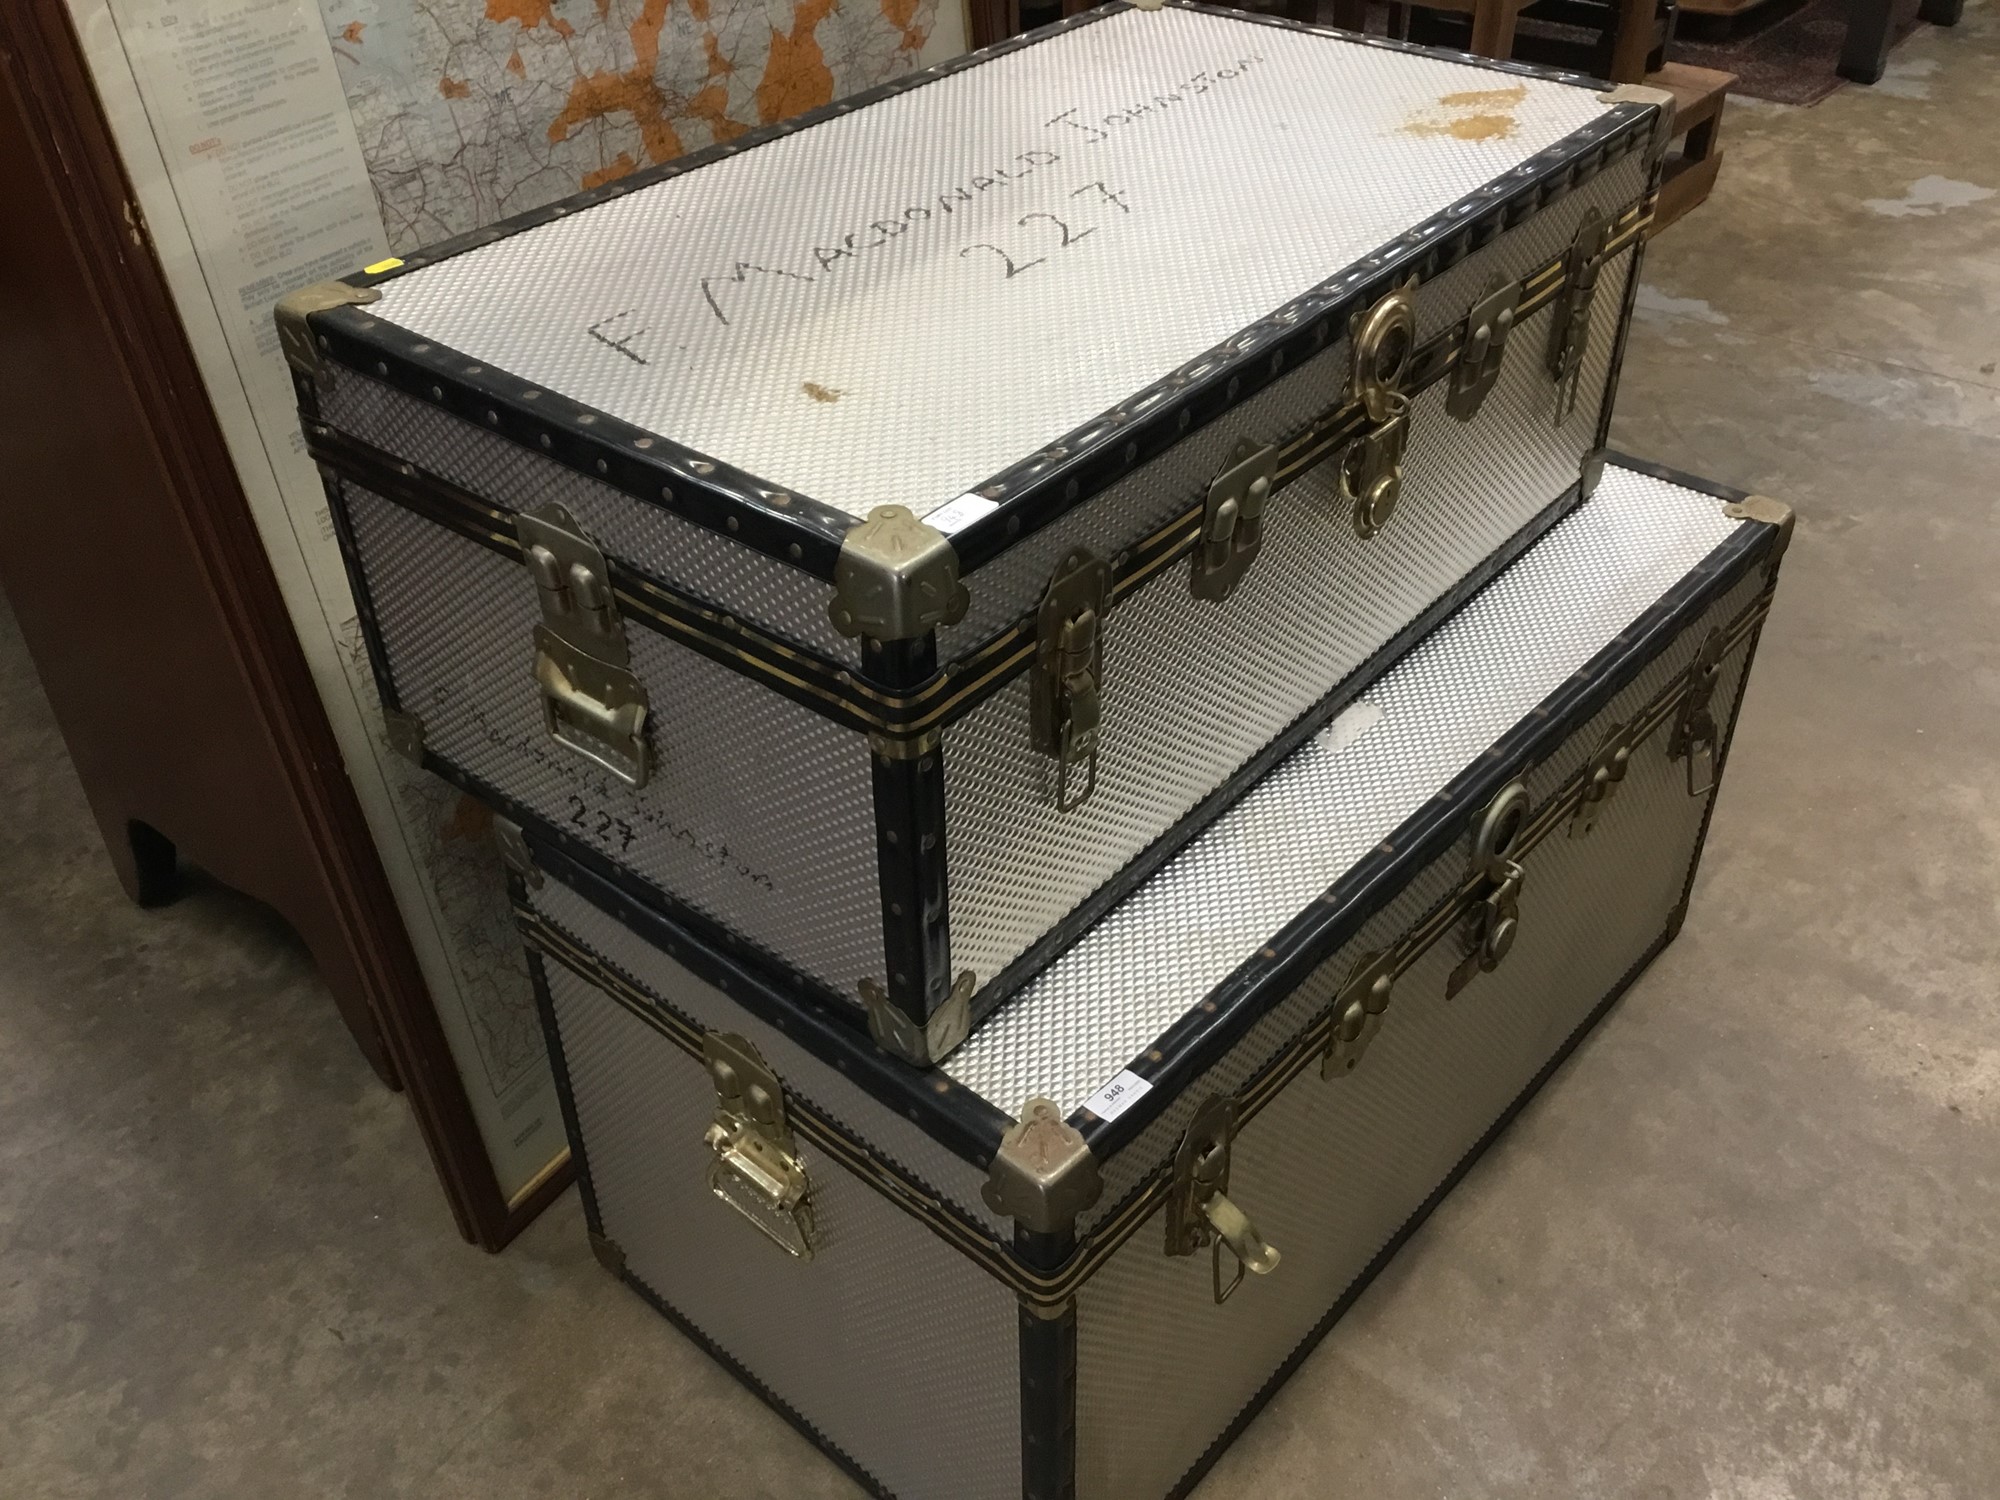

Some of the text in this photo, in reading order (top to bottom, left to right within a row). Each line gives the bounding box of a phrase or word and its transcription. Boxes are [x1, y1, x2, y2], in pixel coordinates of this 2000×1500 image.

[700, 150, 1061, 325] MACDONALD
[959, 181, 1131, 280] 227
[568, 794, 637, 852] 227
[1104, 1084, 1125, 1102] 948
